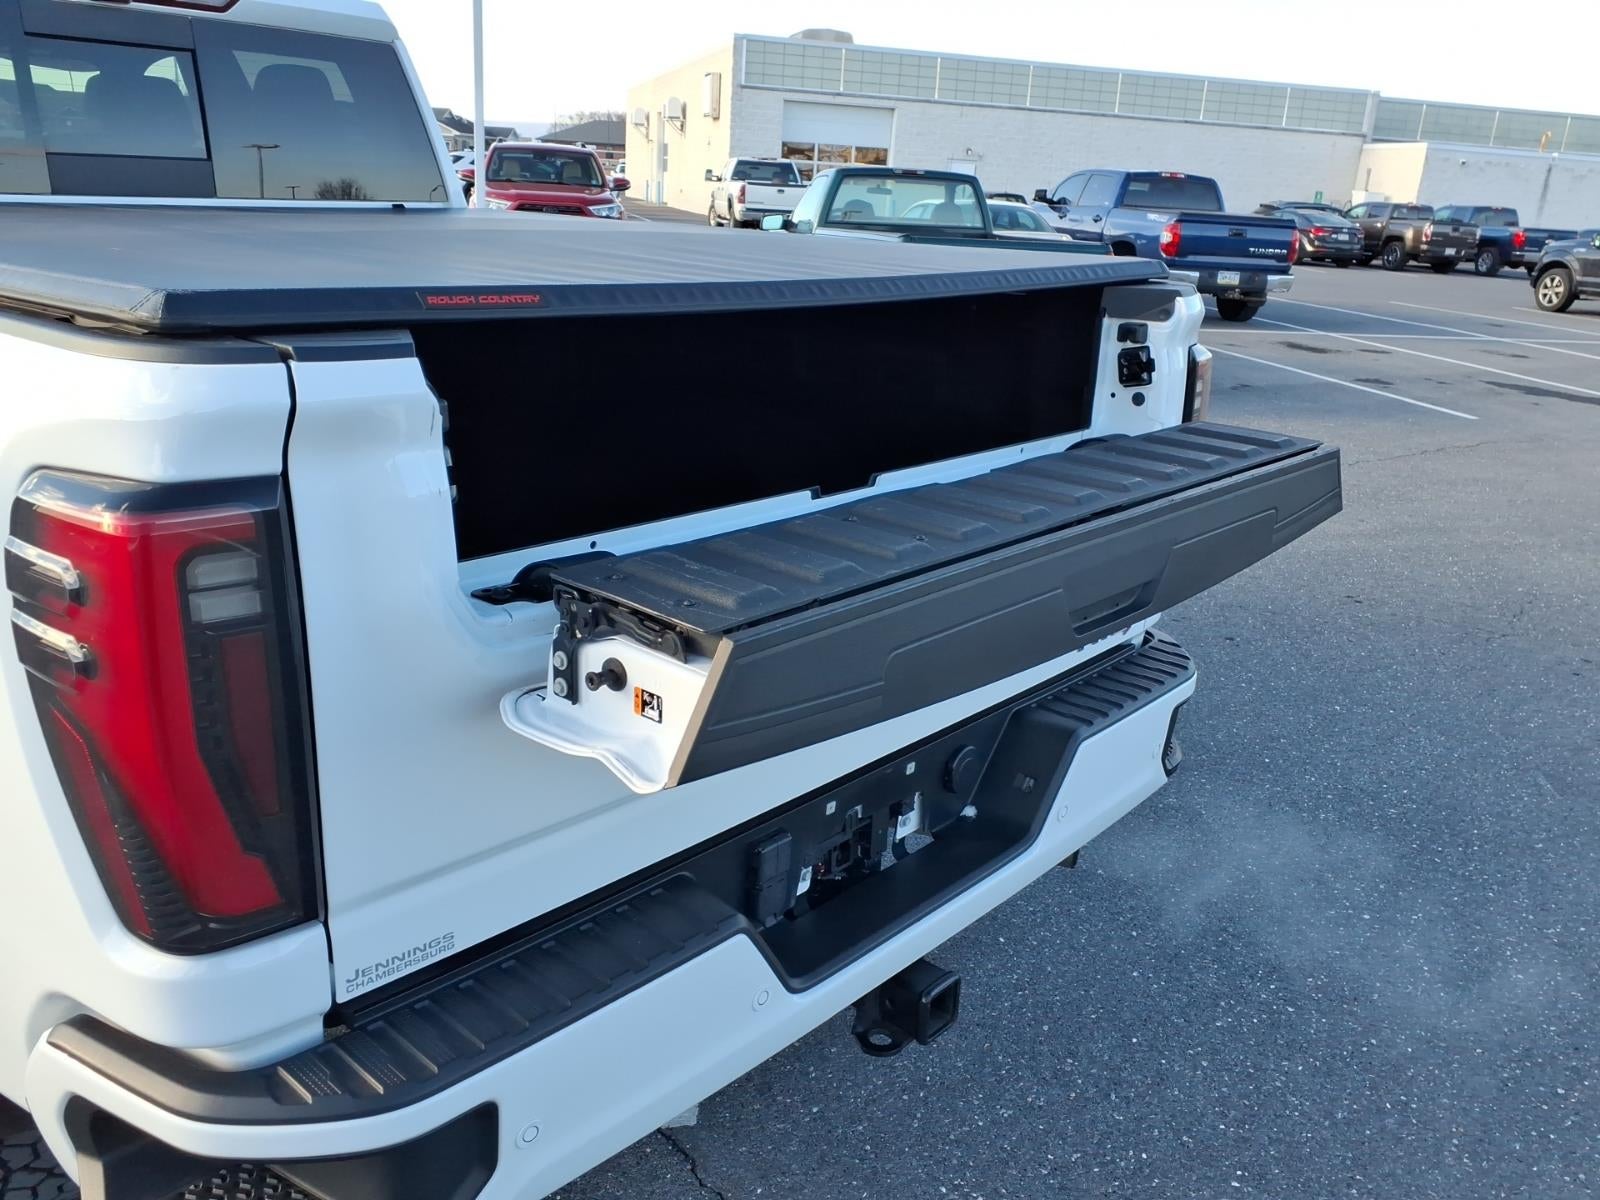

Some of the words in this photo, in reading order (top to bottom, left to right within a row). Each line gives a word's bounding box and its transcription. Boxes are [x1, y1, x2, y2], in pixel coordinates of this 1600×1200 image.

[1248, 247, 1288, 256] TUNDRA
[426, 295, 476, 305] ROUGH
[478, 294, 540, 304] COUNTRY
[345, 931, 455, 983] JENNINGS
[345, 940, 456, 994] CHAMBERSBURG
